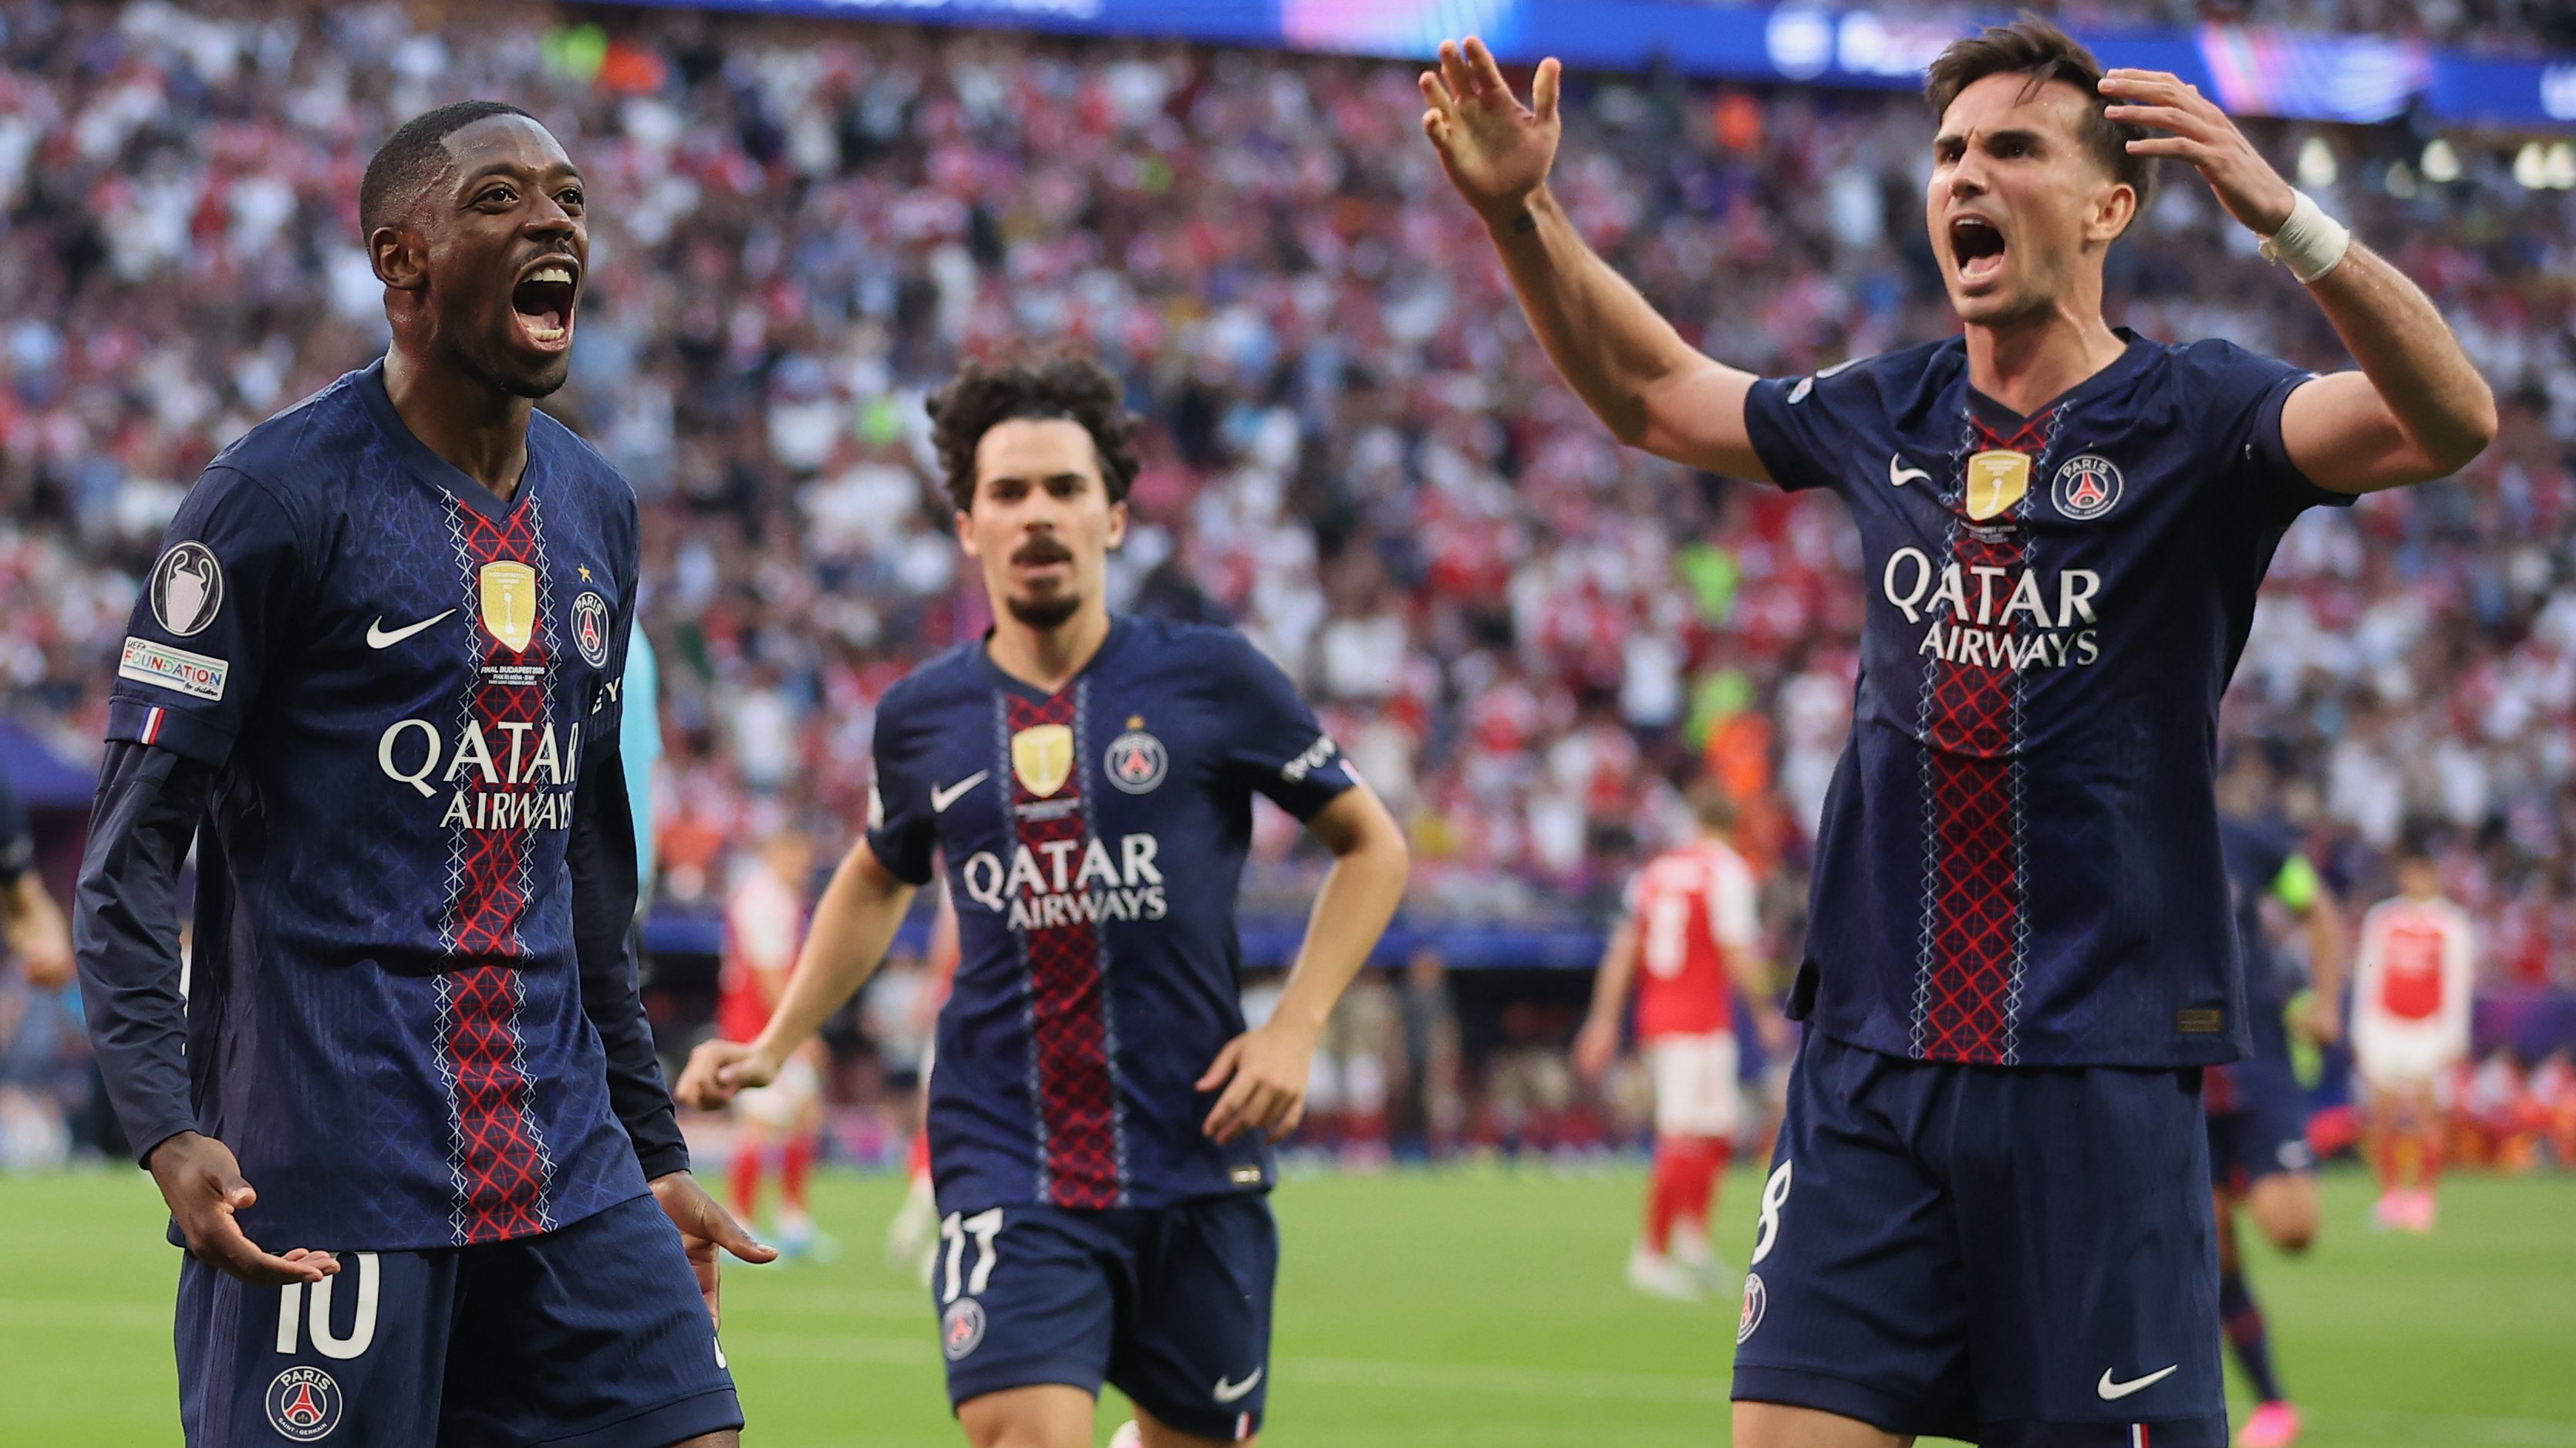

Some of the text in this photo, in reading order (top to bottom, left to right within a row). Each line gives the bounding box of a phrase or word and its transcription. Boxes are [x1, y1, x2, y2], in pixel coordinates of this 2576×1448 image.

[2062, 459, 2109, 478] PARIS
[575, 596, 602, 616] PARIS
[1883, 546, 2101, 628] QATAR
[123, 650, 222, 687] FOUNDATION
[127, 640, 147, 650] UEFA
[1918, 621, 2099, 670] AIRWAYS
[499, 666, 531, 674] BUDAPEST
[378, 719, 579, 798] QATAR
[439, 791, 574, 830] AIRWAYS
[963, 832, 1165, 913] QATAR
[1006, 884, 1168, 932] AIRWAYS
[1752, 1159, 1792, 1265] 8
[942, 1207, 1003, 1305] 17
[276, 1251, 381, 1359] 10
[280, 1369, 331, 1391] PARIS
